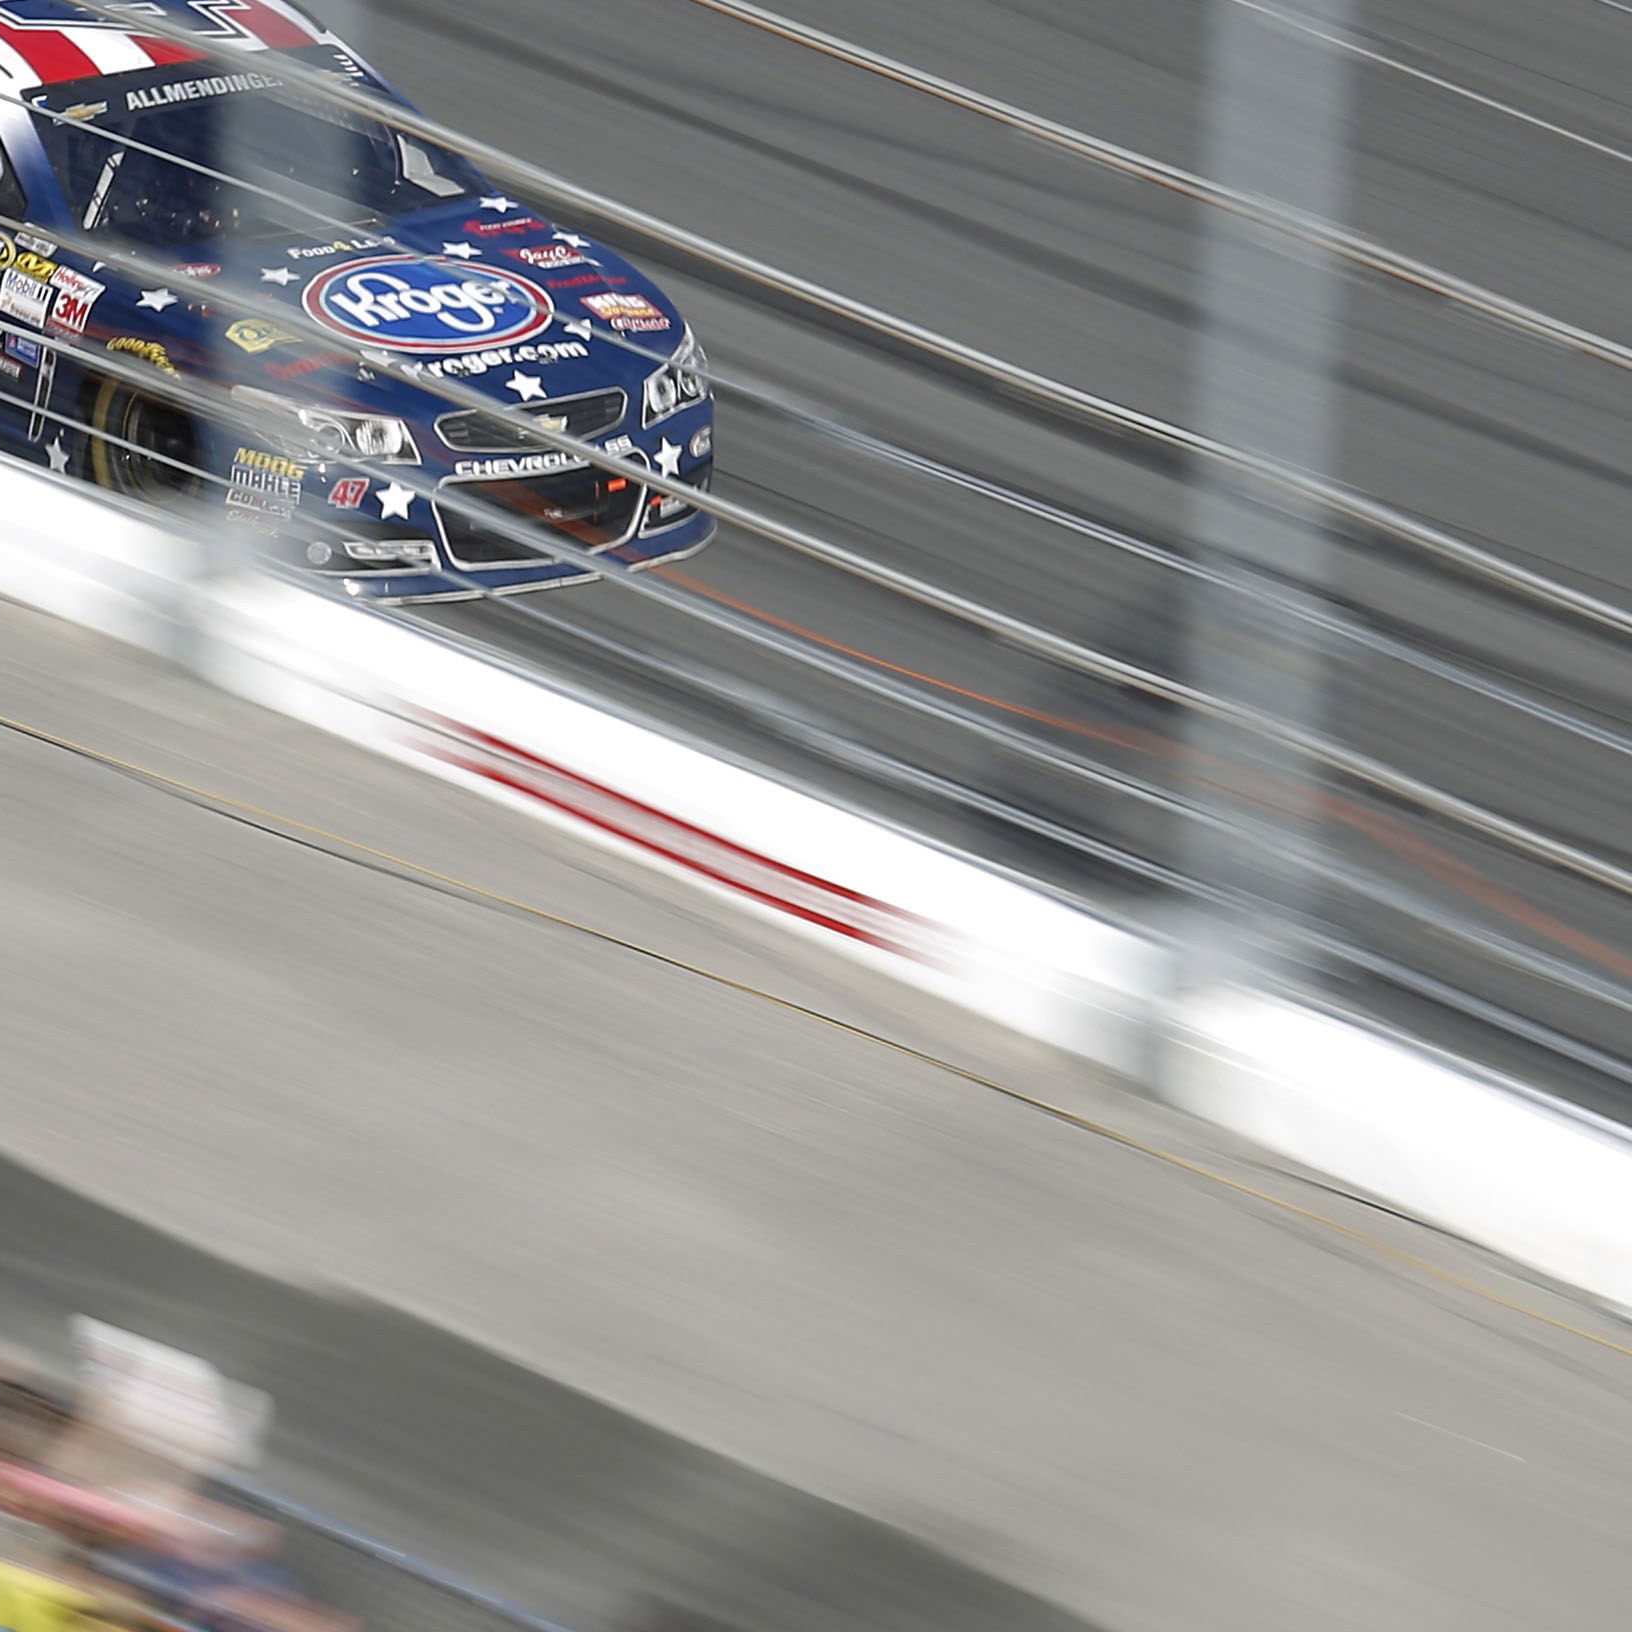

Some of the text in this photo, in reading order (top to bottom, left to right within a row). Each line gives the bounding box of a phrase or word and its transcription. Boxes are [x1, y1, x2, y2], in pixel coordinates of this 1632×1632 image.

[125, 70, 286, 112] ALLMENDINGE
[55, 293, 89, 329] 3M
[329, 271, 511, 333] Kroger
[400, 340, 589, 381] Kroger.com
[453, 442, 604, 477] CHEVROL
[329, 478, 370, 508] 47
